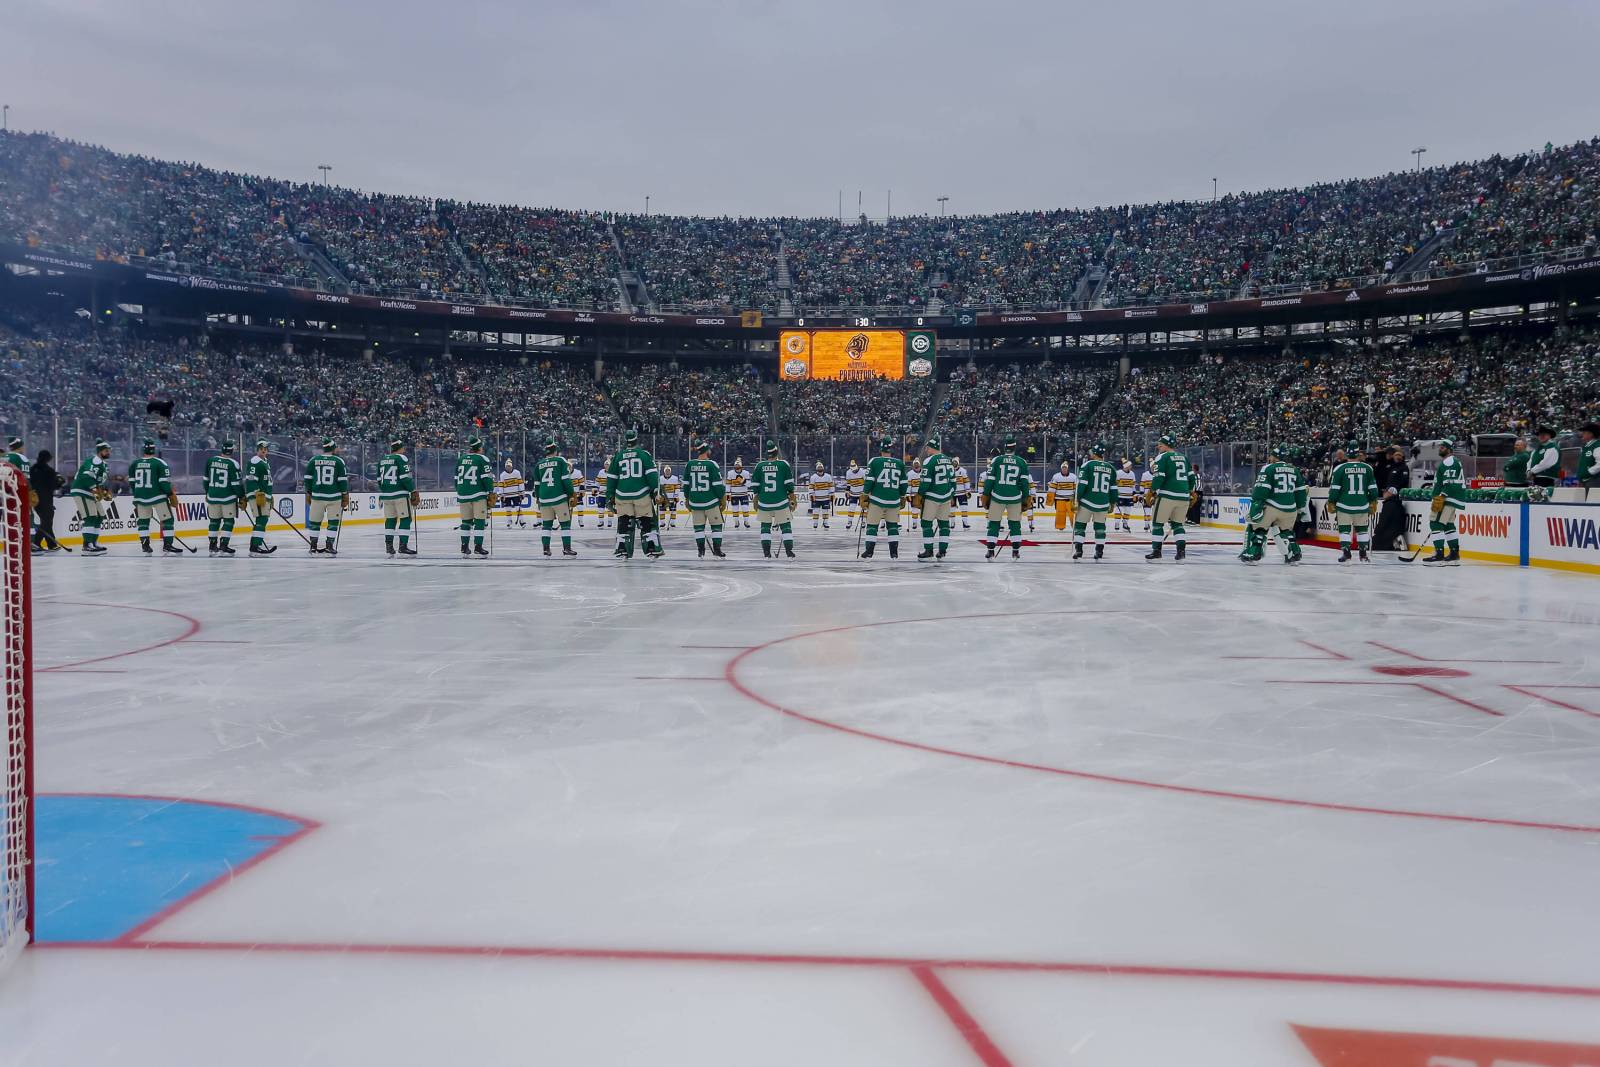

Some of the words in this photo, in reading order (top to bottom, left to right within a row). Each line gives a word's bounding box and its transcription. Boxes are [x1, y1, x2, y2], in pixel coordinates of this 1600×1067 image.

[1532, 264, 1566, 280] Winter
[219, 284, 249, 292] CLASSIC
[316, 294, 350, 304] DISCOVER
[649, 316, 665, 325] Clips
[798, 318, 804, 327] 0
[855, 318, 869, 327] 1:30
[917, 317, 923, 326] 0
[134, 468, 153, 489] 91
[208, 467, 229, 488] 13
[314, 466, 335, 485] 18
[457, 465, 478, 485] 24
[541, 467, 555, 487] 4
[619, 458, 643, 479] 30
[876, 468, 902, 489] 45
[998, 464, 1020, 486] 12
[1175, 461, 1188, 481] 2
[1443, 469, 1457, 478] 47
[690, 472, 710, 492] 15
[764, 472, 777, 492] 5
[1092, 472, 1111, 493] 16
[1274, 473, 1297, 493] 35
[1347, 474, 1365, 495] 11
[1458, 513, 1512, 538] DUNKIN'
